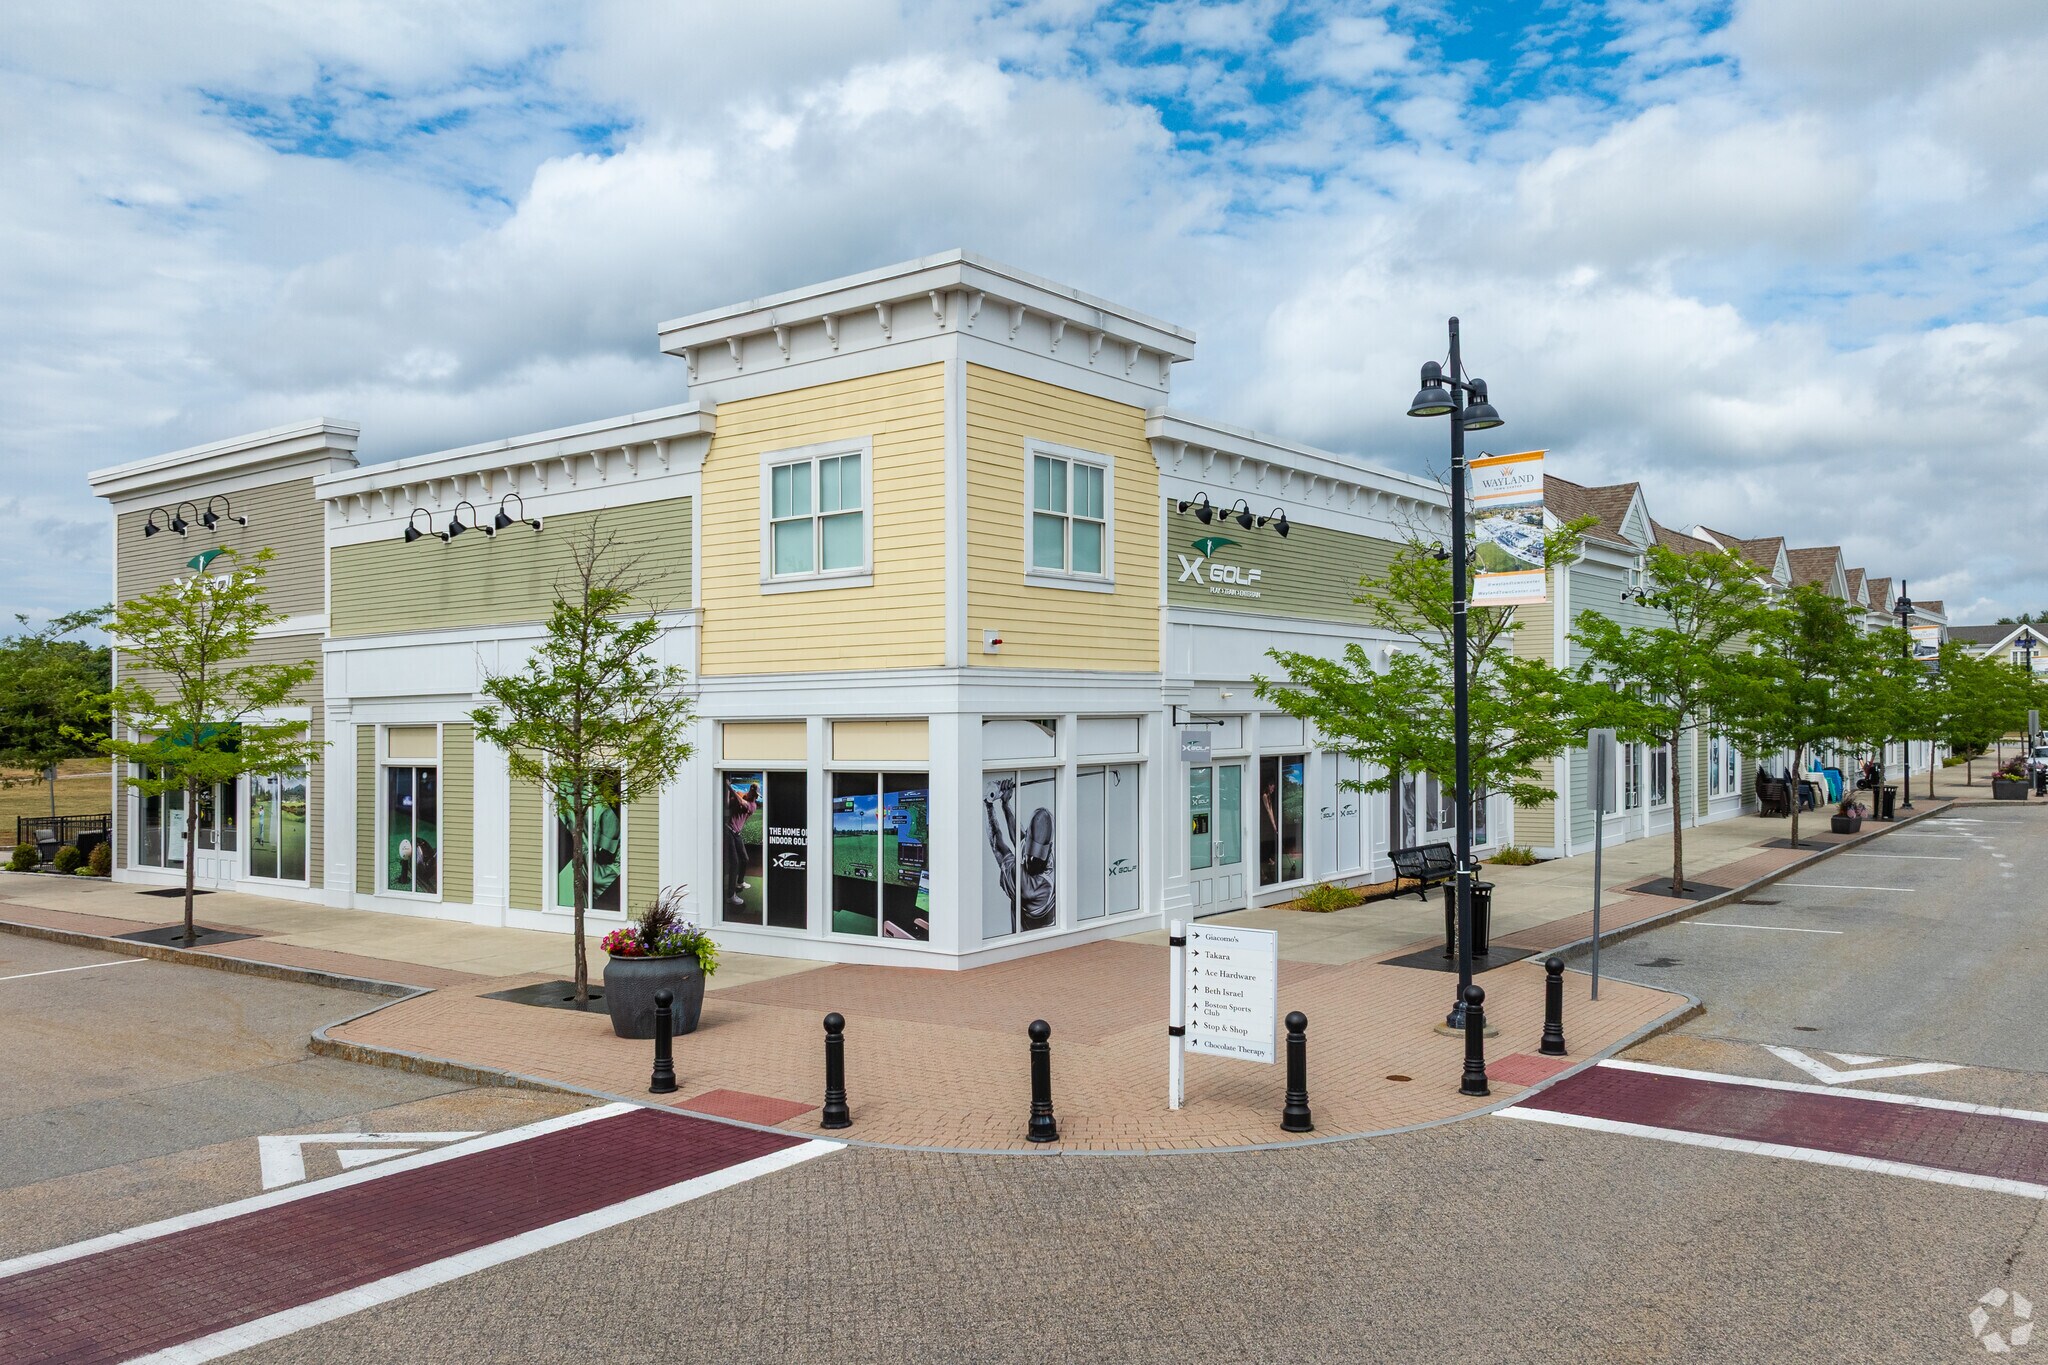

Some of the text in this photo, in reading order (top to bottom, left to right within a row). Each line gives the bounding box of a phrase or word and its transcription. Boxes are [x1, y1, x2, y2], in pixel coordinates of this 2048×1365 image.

[1482, 474, 1535, 488] WAYLAND
[1177, 554, 1262, 586] X GOLF
[769, 827, 781, 836] THE
[782, 827, 801, 836] HOME
[769, 836, 793, 845] INDOOR
[1118, 865, 1137, 874] GOLF
[1205, 933, 1239, 943] Giacomo's
[1205, 951, 1230, 961] Takara
[1204, 969, 1257, 981] Ace Hardware
[1204, 986, 1244, 998] Beth Israel
[1203, 1008, 1220, 1017] Club
[1204, 1000, 1252, 1013] Boston Sports
[1203, 1021, 1248, 1037] Stop & Shop
[1204, 1040, 1266, 1057] Chocolate Therapy
